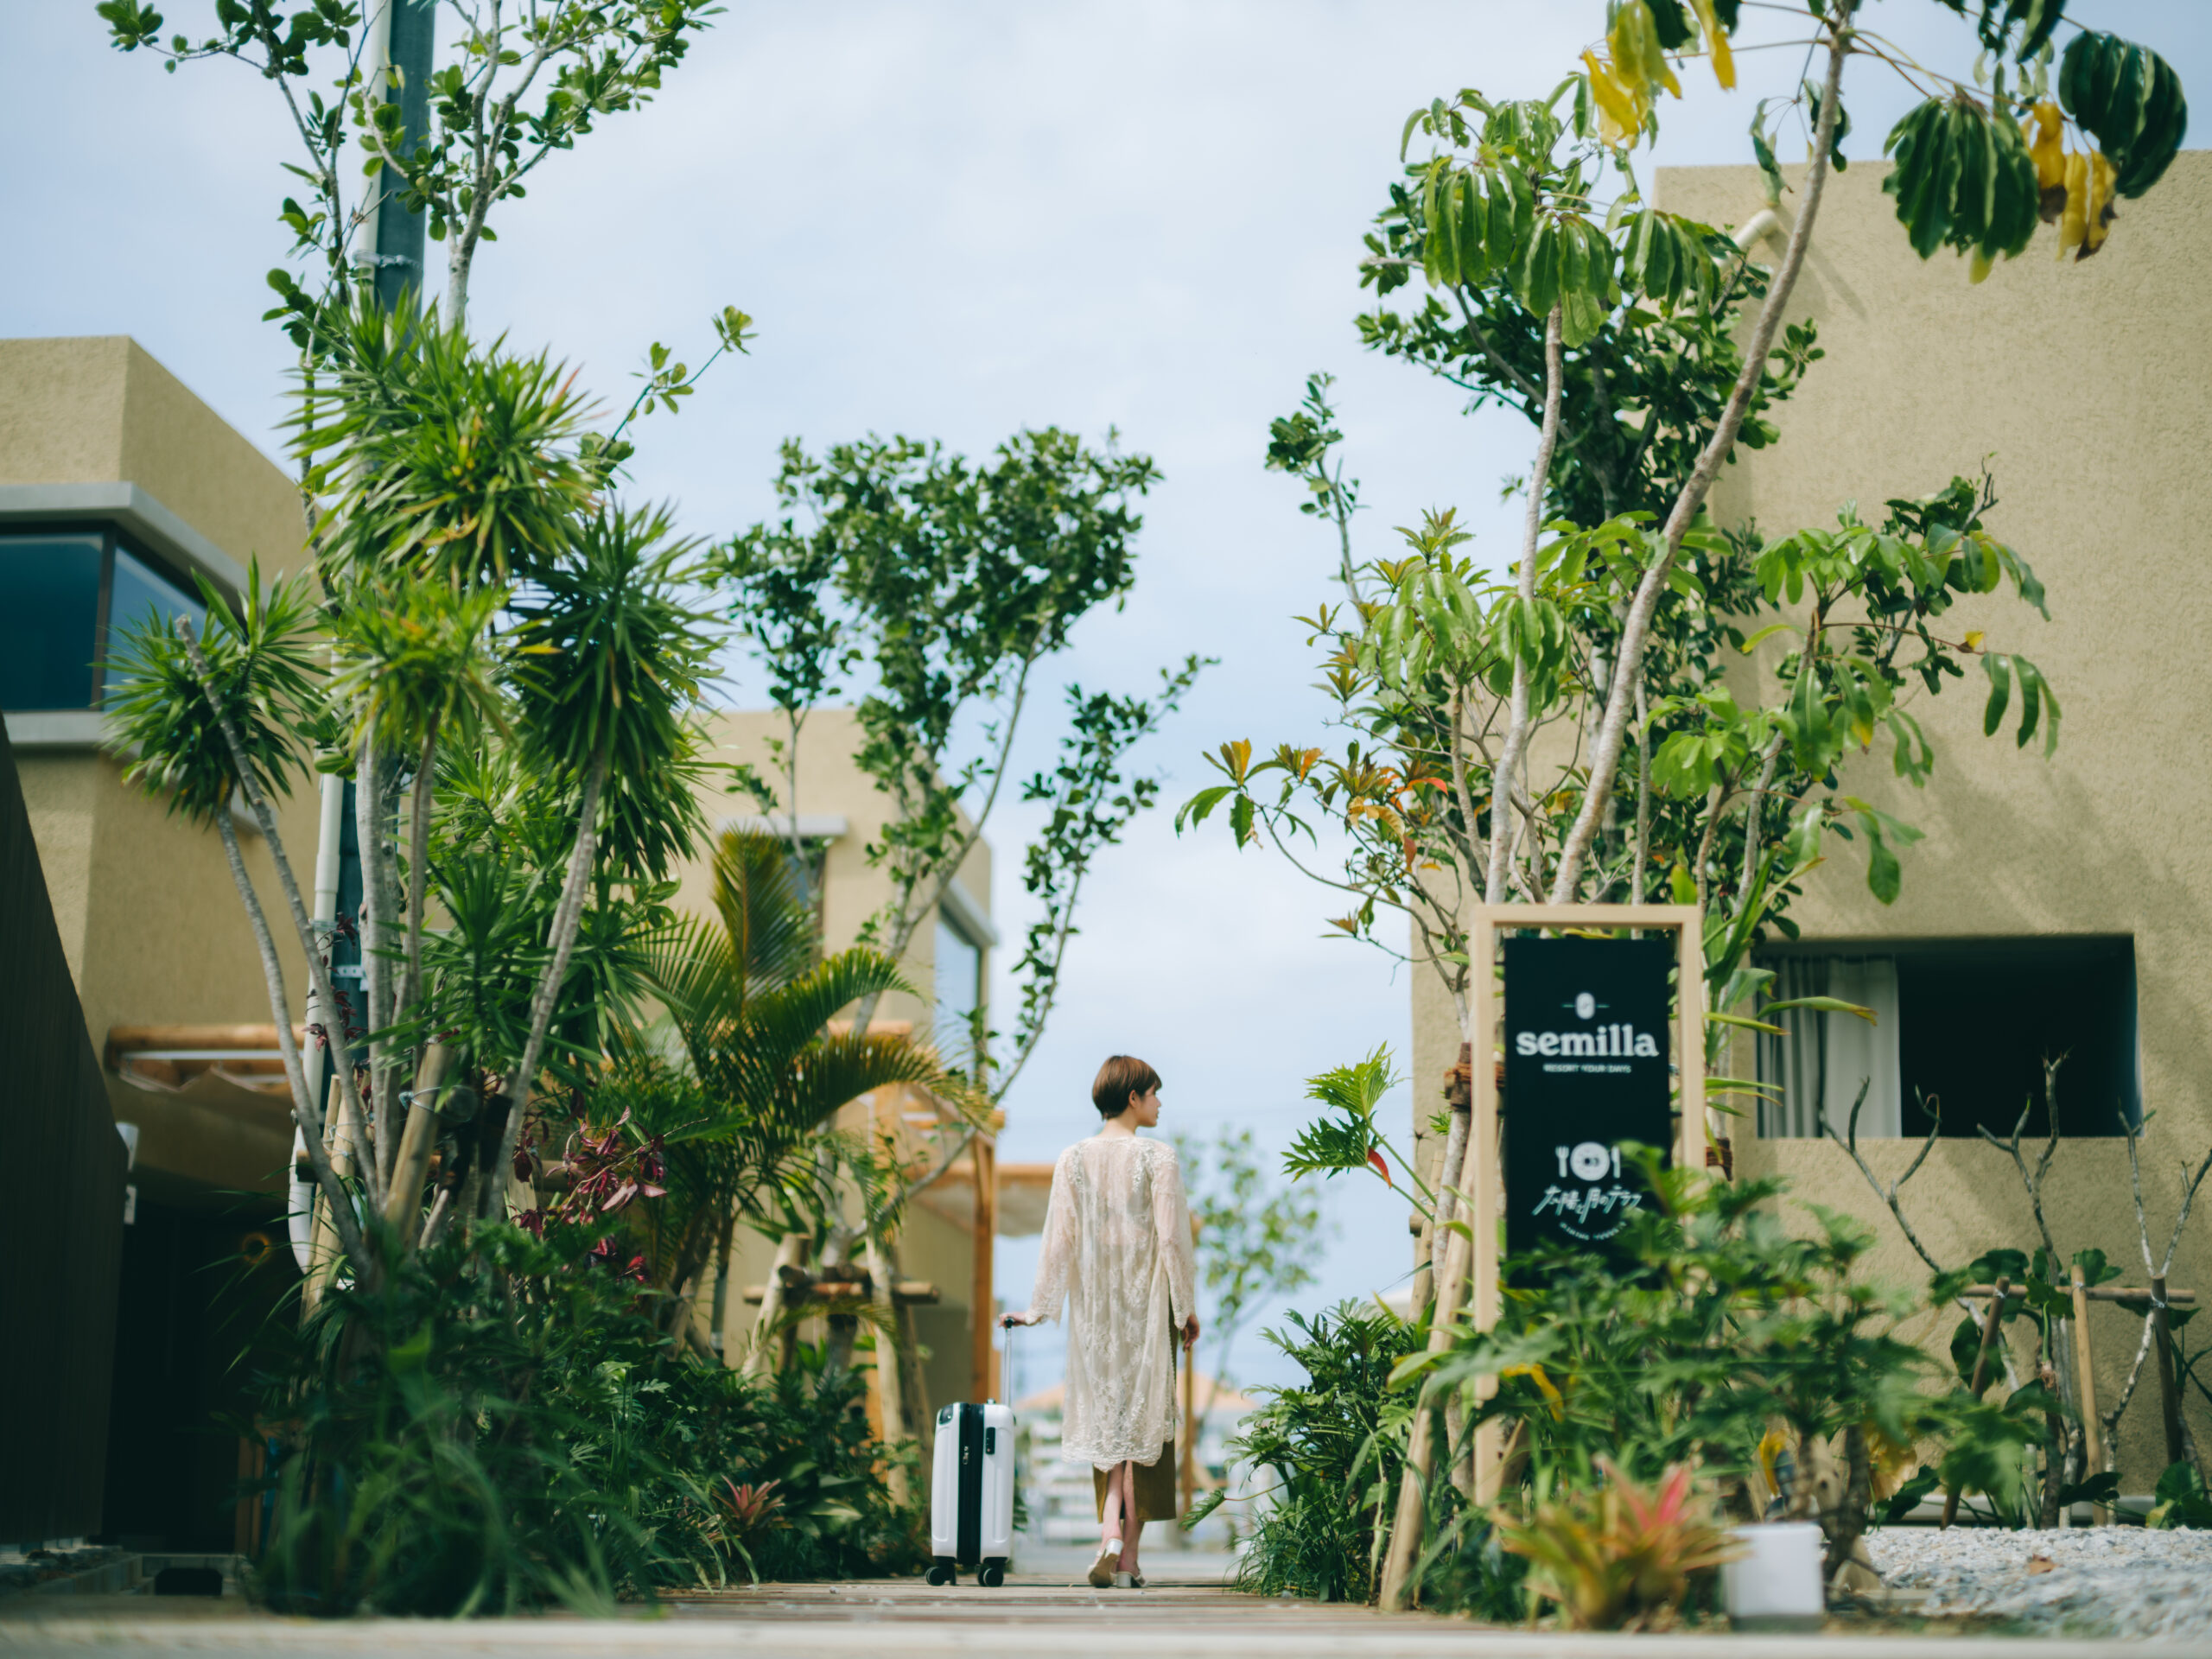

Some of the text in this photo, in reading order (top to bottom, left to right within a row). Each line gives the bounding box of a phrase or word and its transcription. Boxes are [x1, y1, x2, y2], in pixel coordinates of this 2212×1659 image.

[1516, 1023, 1659, 1057] semilla
[1542, 1063, 1631, 1073] RESORT YOUR DAYS
